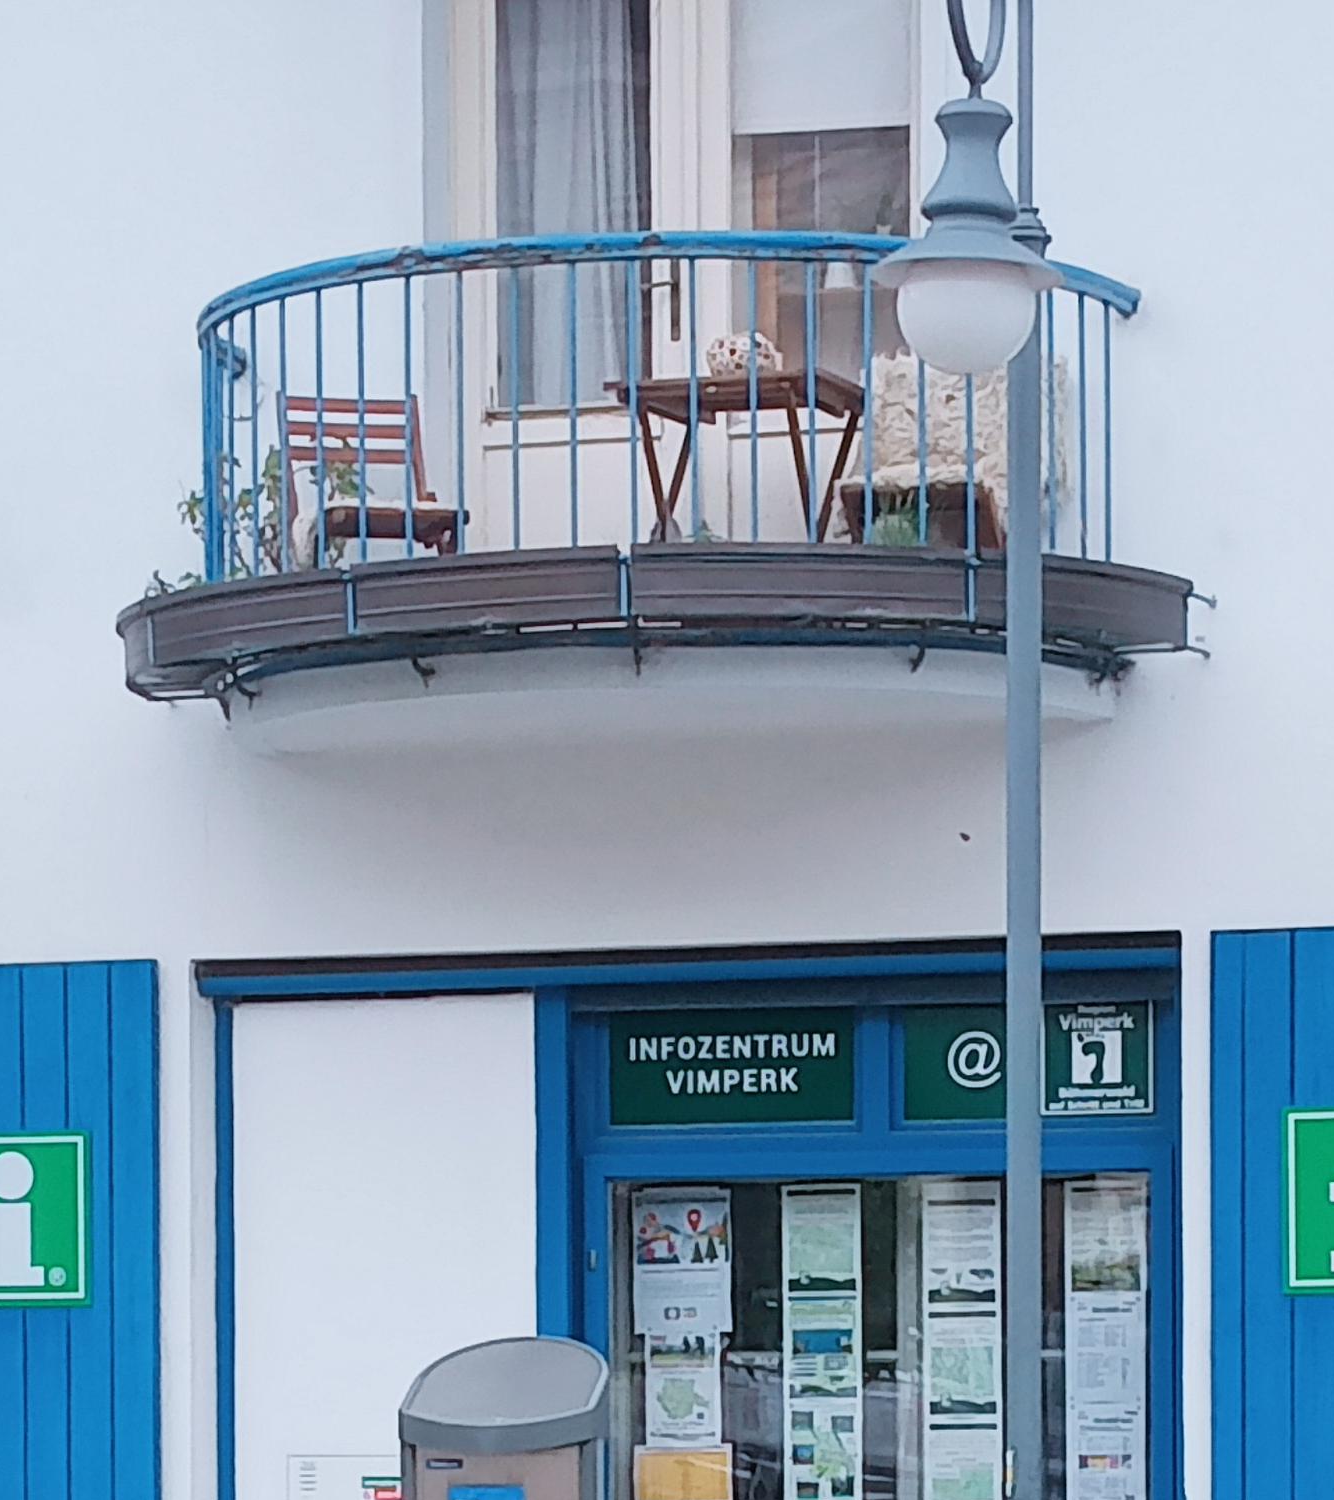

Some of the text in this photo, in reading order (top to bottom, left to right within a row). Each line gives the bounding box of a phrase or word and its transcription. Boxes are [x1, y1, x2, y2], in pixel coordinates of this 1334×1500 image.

[1058, 1011, 1135, 1033] Vimperk
[628, 1033, 836, 1062] INFOZENTRUM
[947, 1030, 1002, 1089] @
[666, 1067, 799, 1095] VIMPERK
